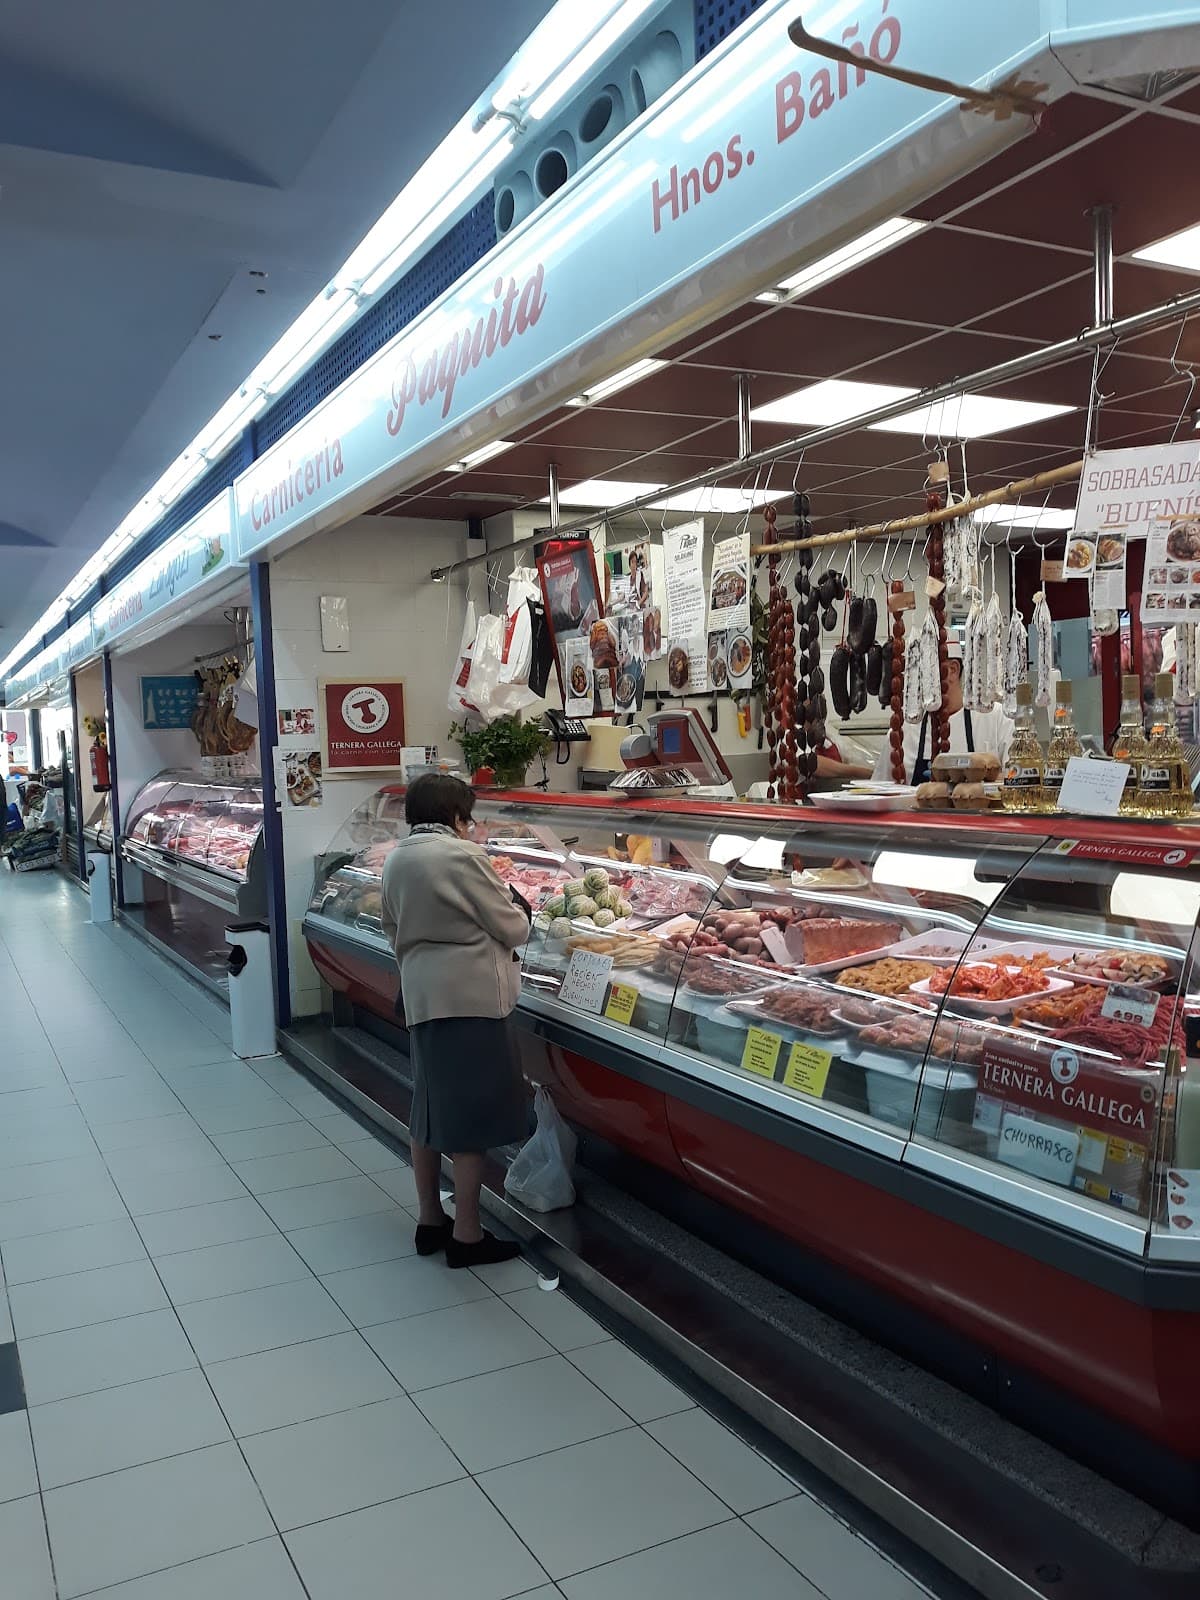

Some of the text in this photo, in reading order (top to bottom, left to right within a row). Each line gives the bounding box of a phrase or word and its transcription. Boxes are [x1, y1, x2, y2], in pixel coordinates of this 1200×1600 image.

[386, 263, 547, 436] Paquita
[651, 134, 755, 234] Hnos.
[330, 740, 402, 749] TERNERA GALLEGA
[1076, 843, 1162, 860] TERNERA GALLEGA
[983, 1061, 1146, 1130] TERNERA GALLEGA
[1003, 1127, 1074, 1164] CHURRASCO
